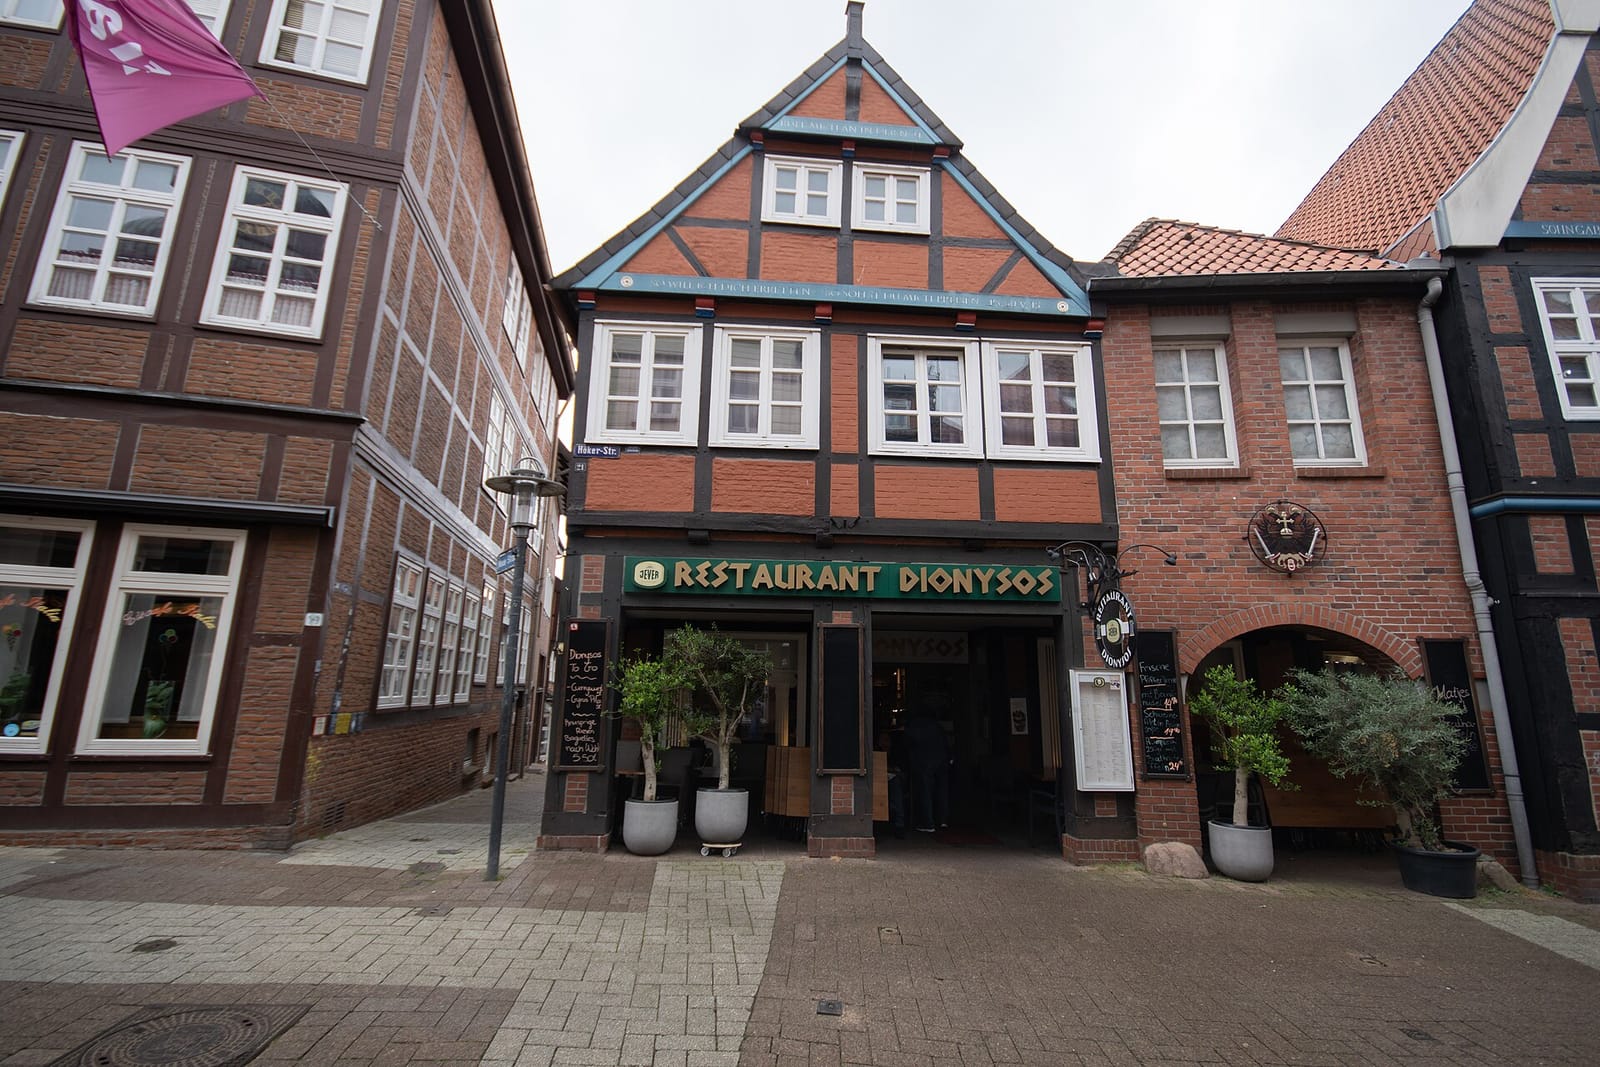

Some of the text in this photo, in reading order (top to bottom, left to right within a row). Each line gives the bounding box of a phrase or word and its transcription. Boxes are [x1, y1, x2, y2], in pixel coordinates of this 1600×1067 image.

[577, 445, 617, 456] Höker-Str.
[639, 569, 660, 580] JEVER
[674, 560, 1054, 596] RESTAURANT DIONYSOS
[1095, 590, 1133, 622] RESTAURANT
[1101, 645, 1132, 668] DIONYSOS
[569, 661, 599, 673] To Go
